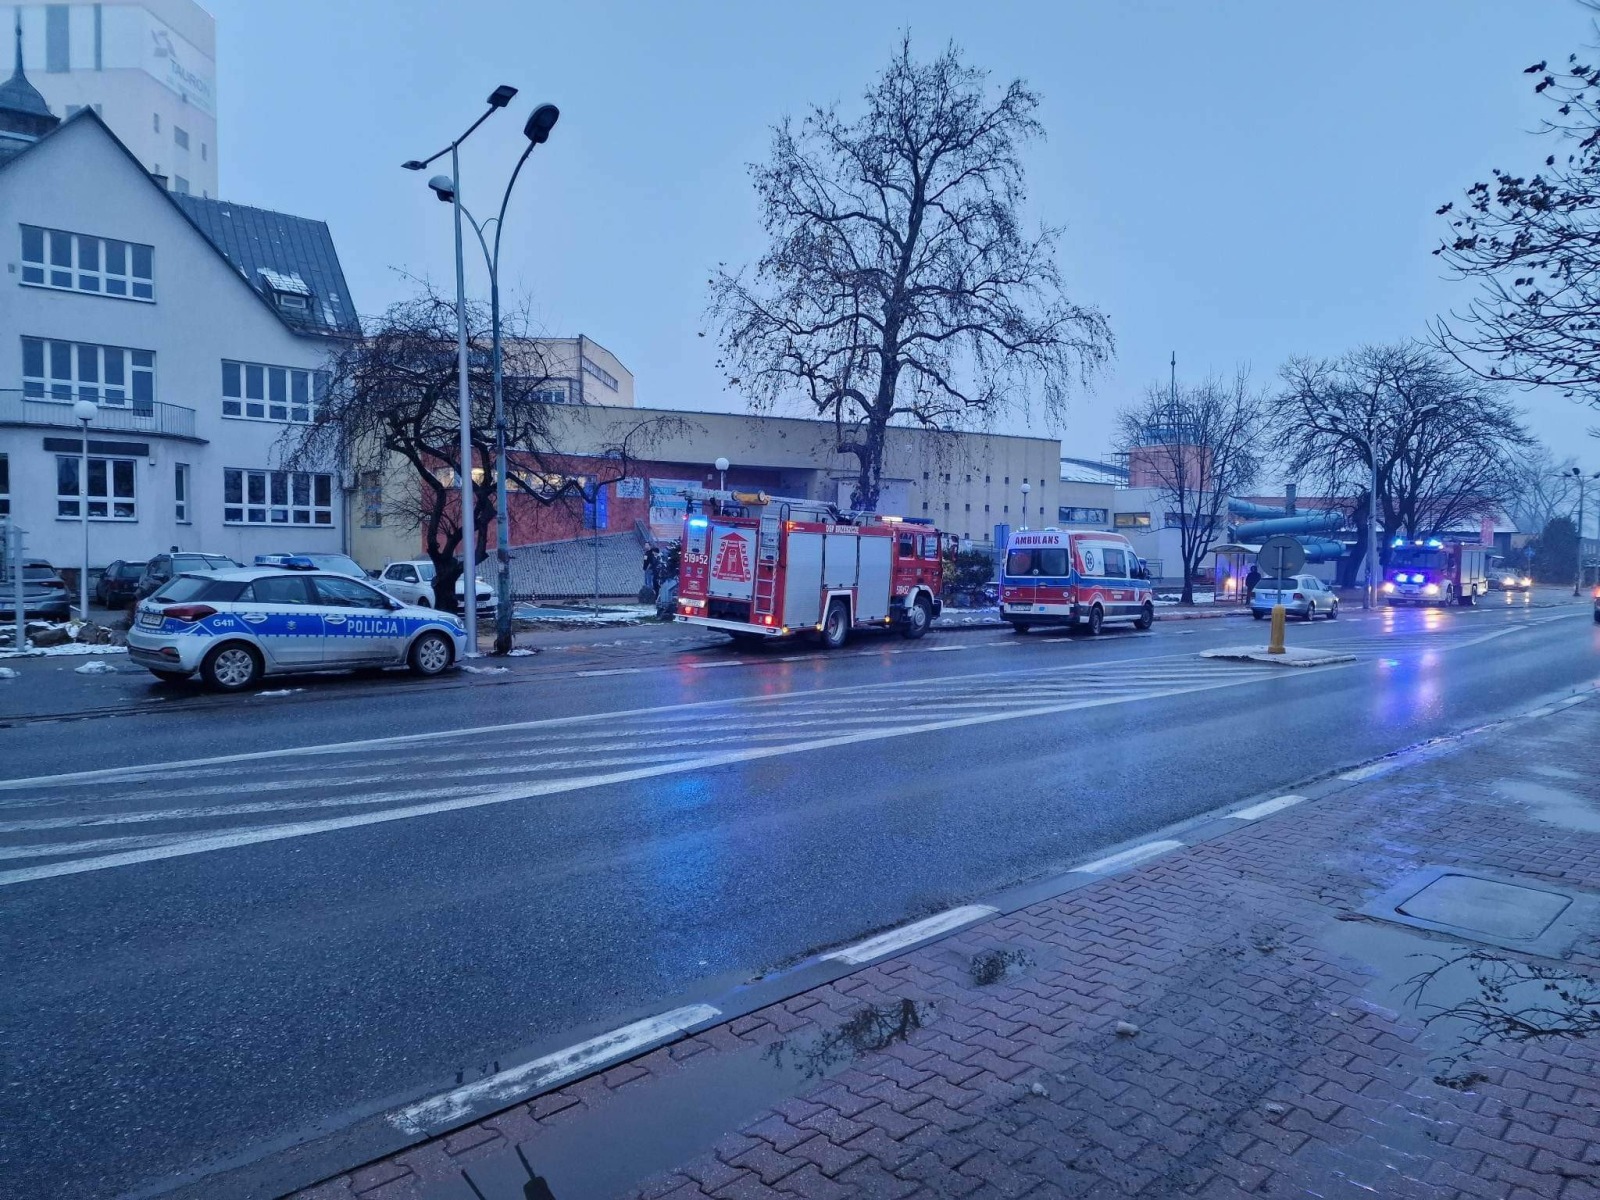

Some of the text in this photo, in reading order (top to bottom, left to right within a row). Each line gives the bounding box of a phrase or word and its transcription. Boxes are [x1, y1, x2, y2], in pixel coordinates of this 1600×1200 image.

[170, 58, 210, 98] TAURON
[1015, 536, 1059, 544] AMBULANS
[213, 619, 234, 627] G411
[347, 620, 398, 634] POLICJA
